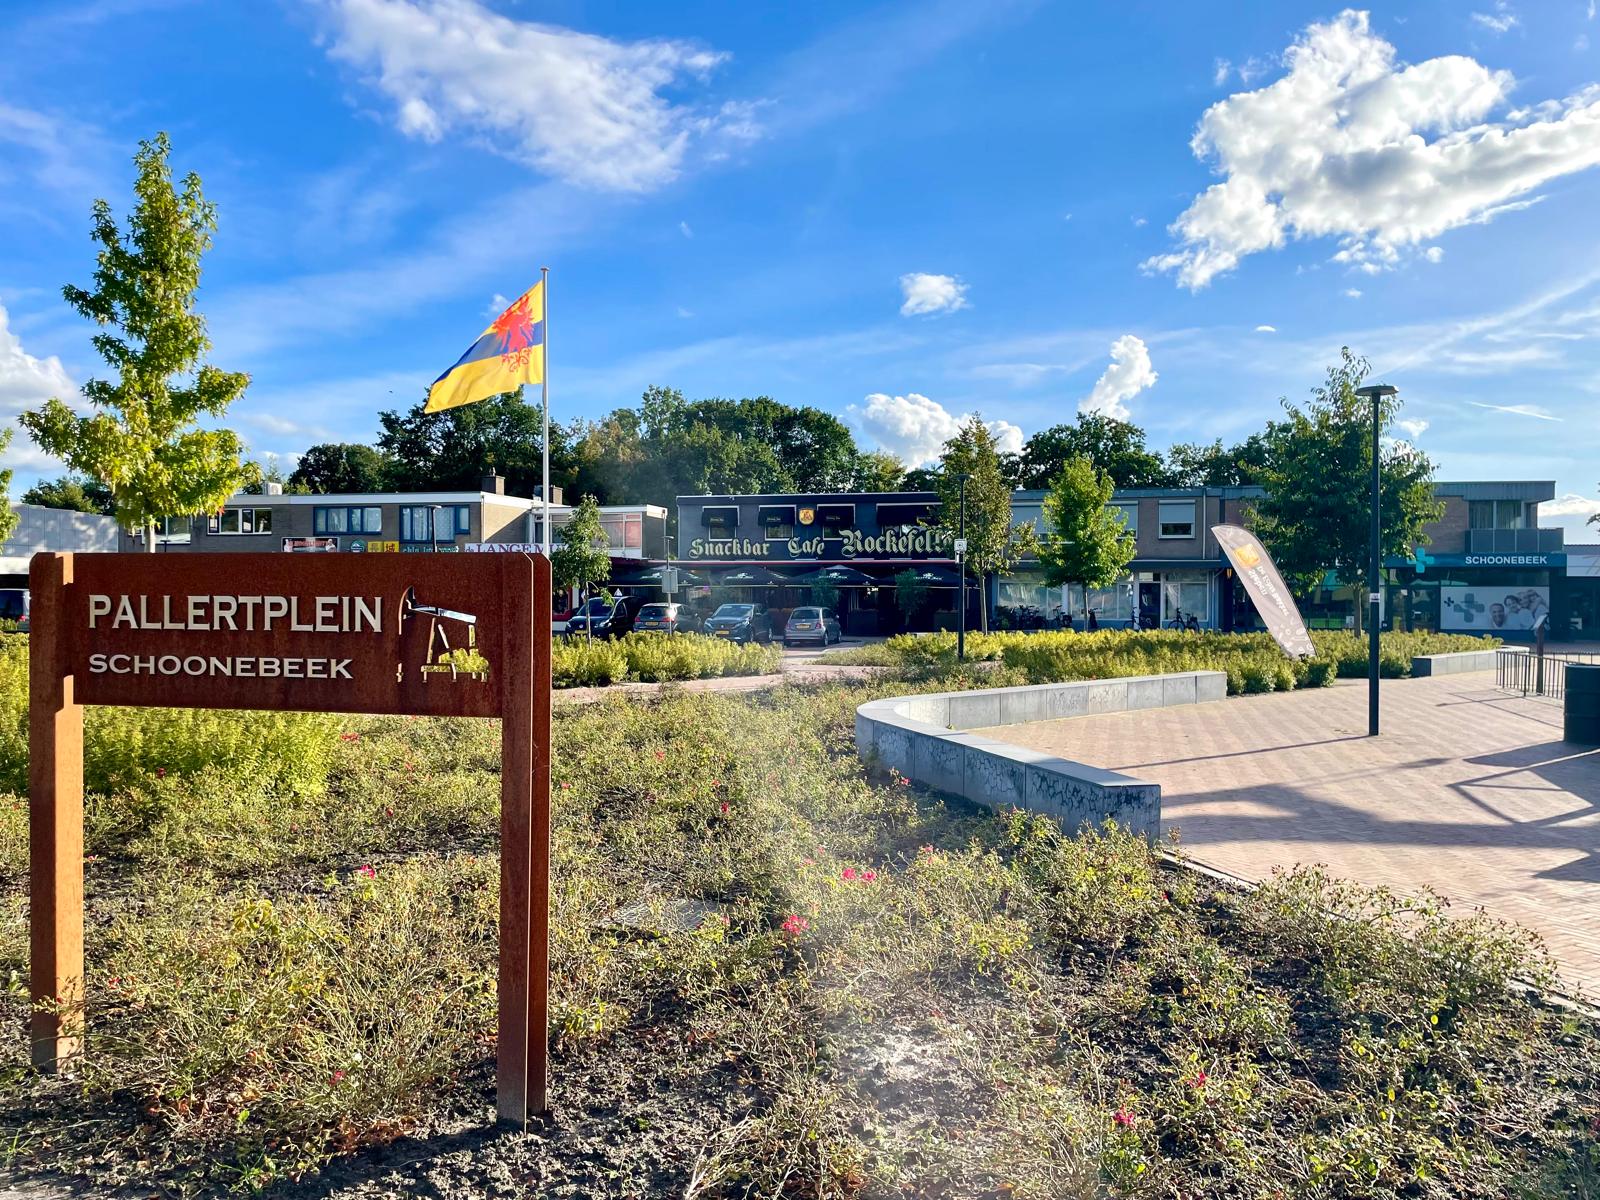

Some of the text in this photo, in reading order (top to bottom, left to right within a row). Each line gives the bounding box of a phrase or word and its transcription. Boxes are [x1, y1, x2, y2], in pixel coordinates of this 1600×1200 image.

[688, 538, 770, 558] Snackbar
[1465, 556, 1547, 565] SCHOONEBEEK
[88, 594, 383, 633] PALLERTPLEIN
[88, 653, 353, 679] SCHOONEBEEK
